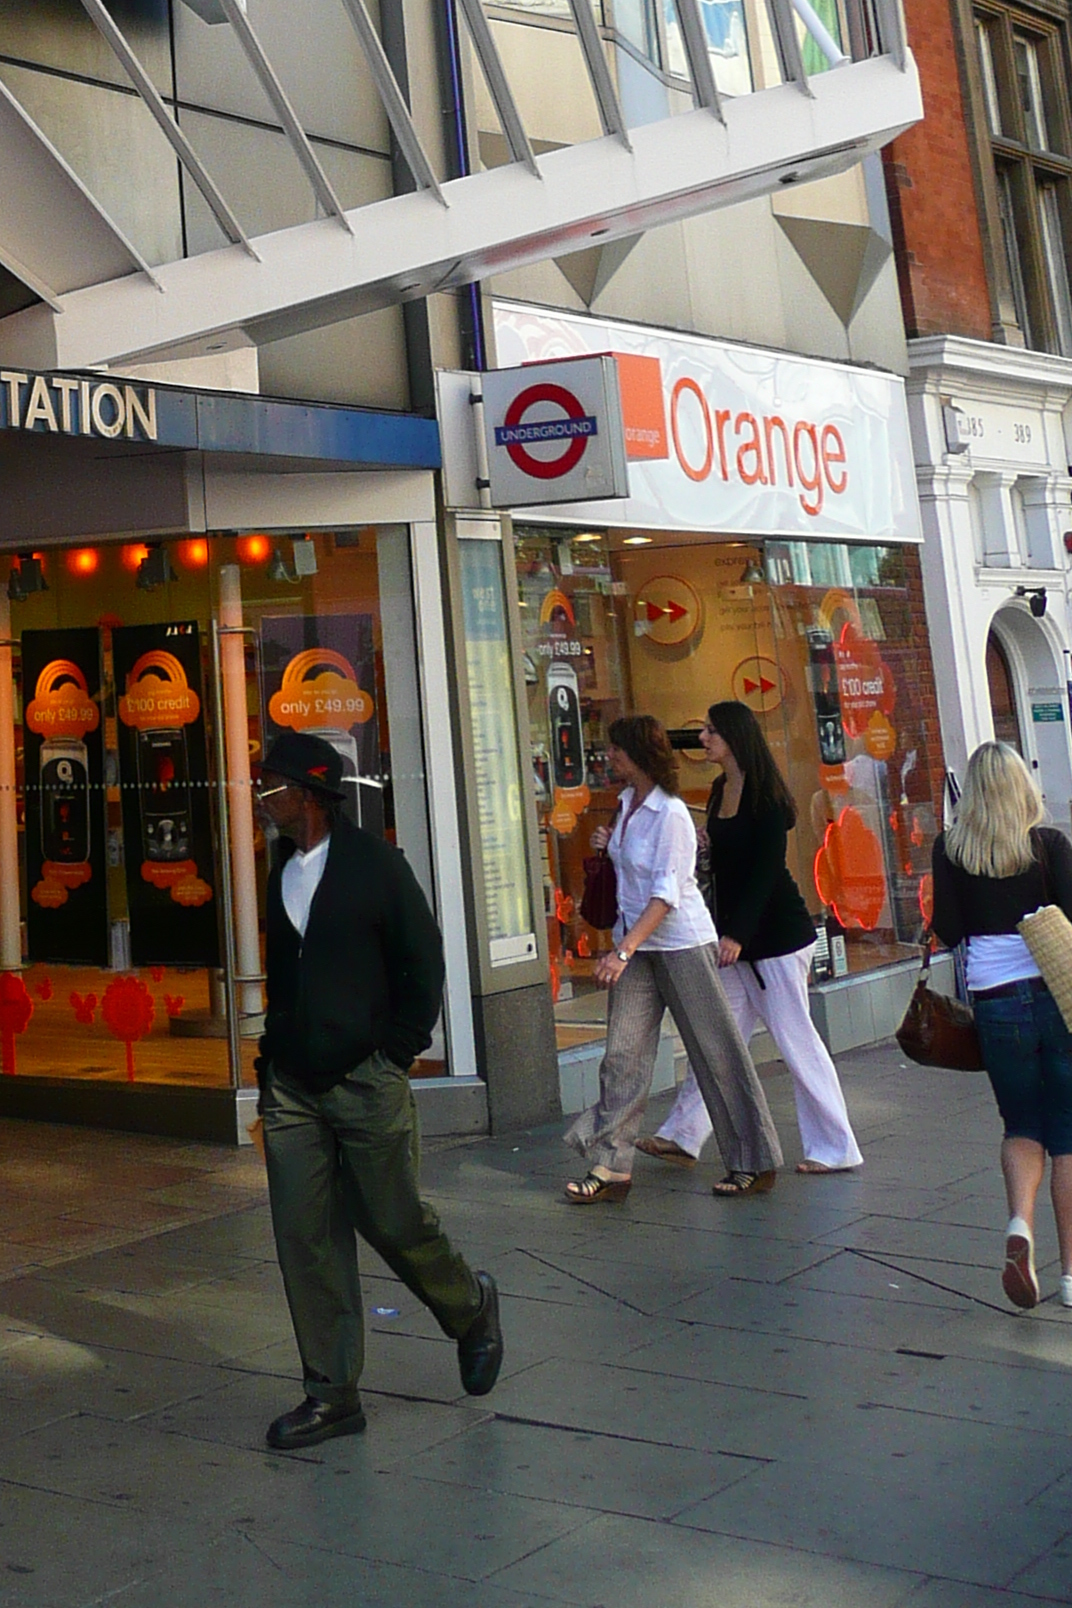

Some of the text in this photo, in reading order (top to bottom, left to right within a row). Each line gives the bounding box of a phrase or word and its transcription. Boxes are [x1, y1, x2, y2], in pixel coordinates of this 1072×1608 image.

[500, 421, 592, 442] UNDERGROUND
[670, 377, 848, 516] Orange
[156, 696, 190, 711] credit
[280, 698, 365, 717] only £49.99
[33, 707, 94, 725] only £49.99
